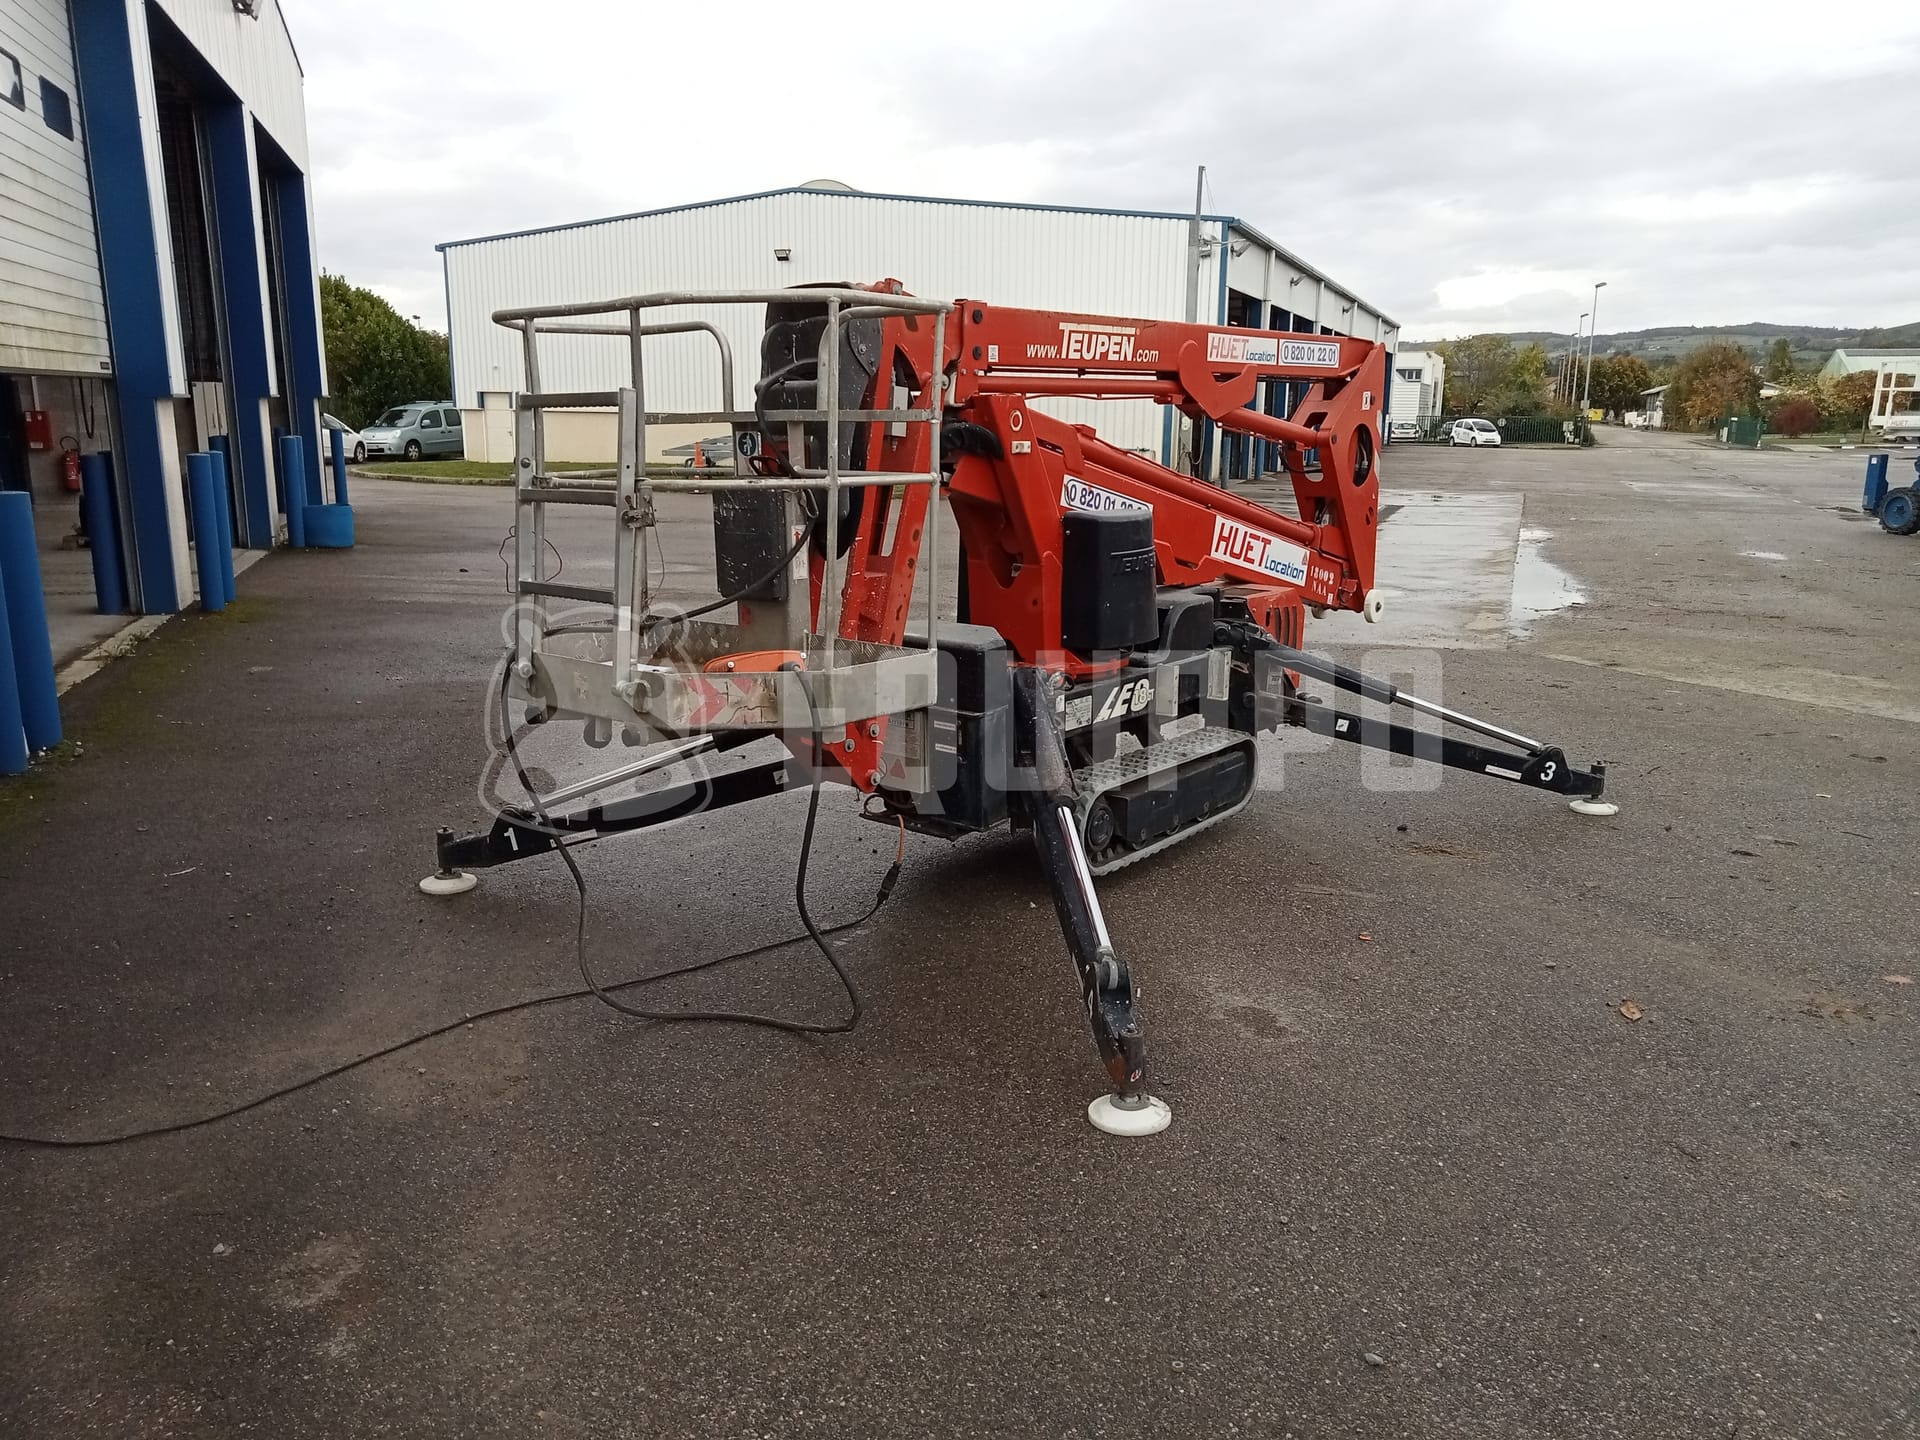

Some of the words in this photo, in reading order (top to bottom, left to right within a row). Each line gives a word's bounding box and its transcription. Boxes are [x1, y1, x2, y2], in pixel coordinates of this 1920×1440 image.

[1026, 322, 1159, 363] www.TEUPEN.com
[1209, 336, 1249, 360] HUET
[1245, 349, 1276, 362] Location
[1283, 345, 1289, 360] 0
[1290, 345, 1305, 360] 820
[1306, 346, 1315, 361] 01
[1317, 347, 1327, 361] 22
[1328, 347, 1336, 362] 01
[1069, 484, 1077, 503] 0
[1079, 487, 1101, 510] 820
[1103, 496, 1116, 511] 01
[1215, 522, 1272, 567] HUET
[1264, 555, 1305, 581] Location
[1093, 678, 1150, 723] LEO
[1540, 761, 1557, 781] 3
[503, 827, 519, 851] 1
